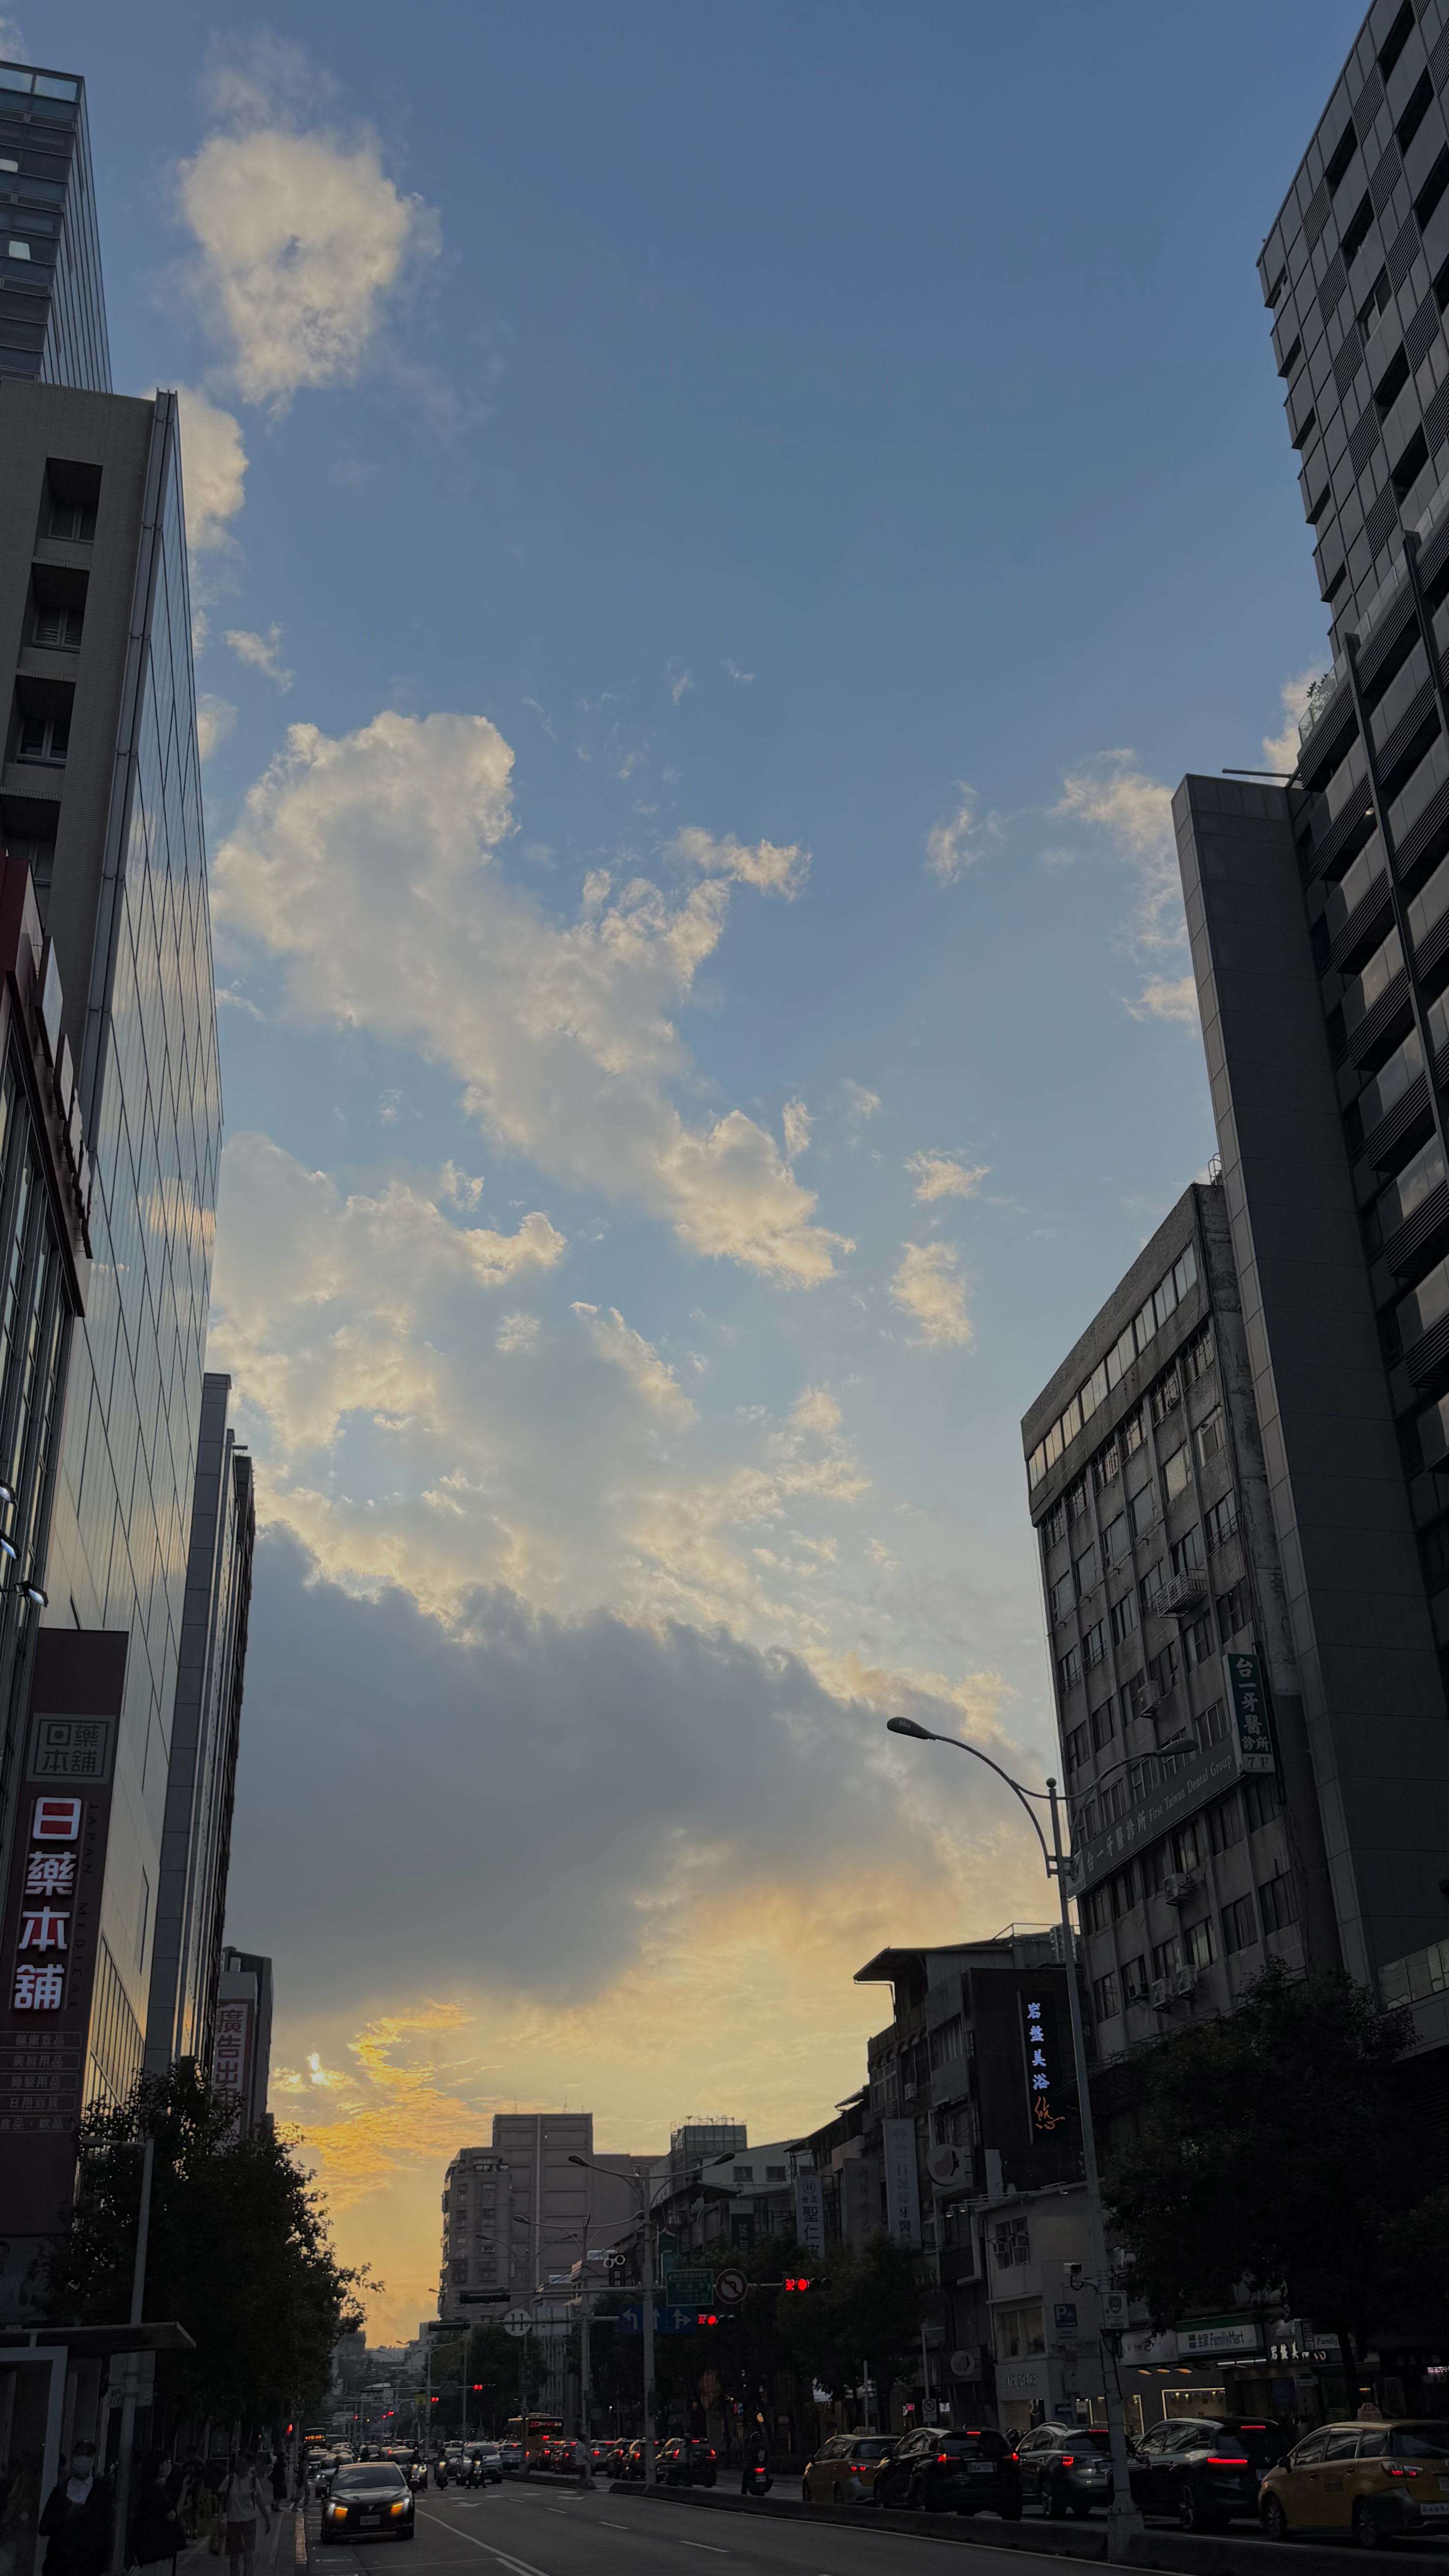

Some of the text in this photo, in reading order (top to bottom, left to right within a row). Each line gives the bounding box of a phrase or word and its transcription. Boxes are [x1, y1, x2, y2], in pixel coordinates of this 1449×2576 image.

[1149, 1755, 1232, 1821] First Taiwan Dental Group
[14, 1796, 82, 2010] 日藥本舖
[70, 1803, 99, 2008] JAPAN MEDICAL
[1210, 2331, 1243, 2347] FamilyMart
[1006, 2373, 1036, 2387] AIR SPACE
